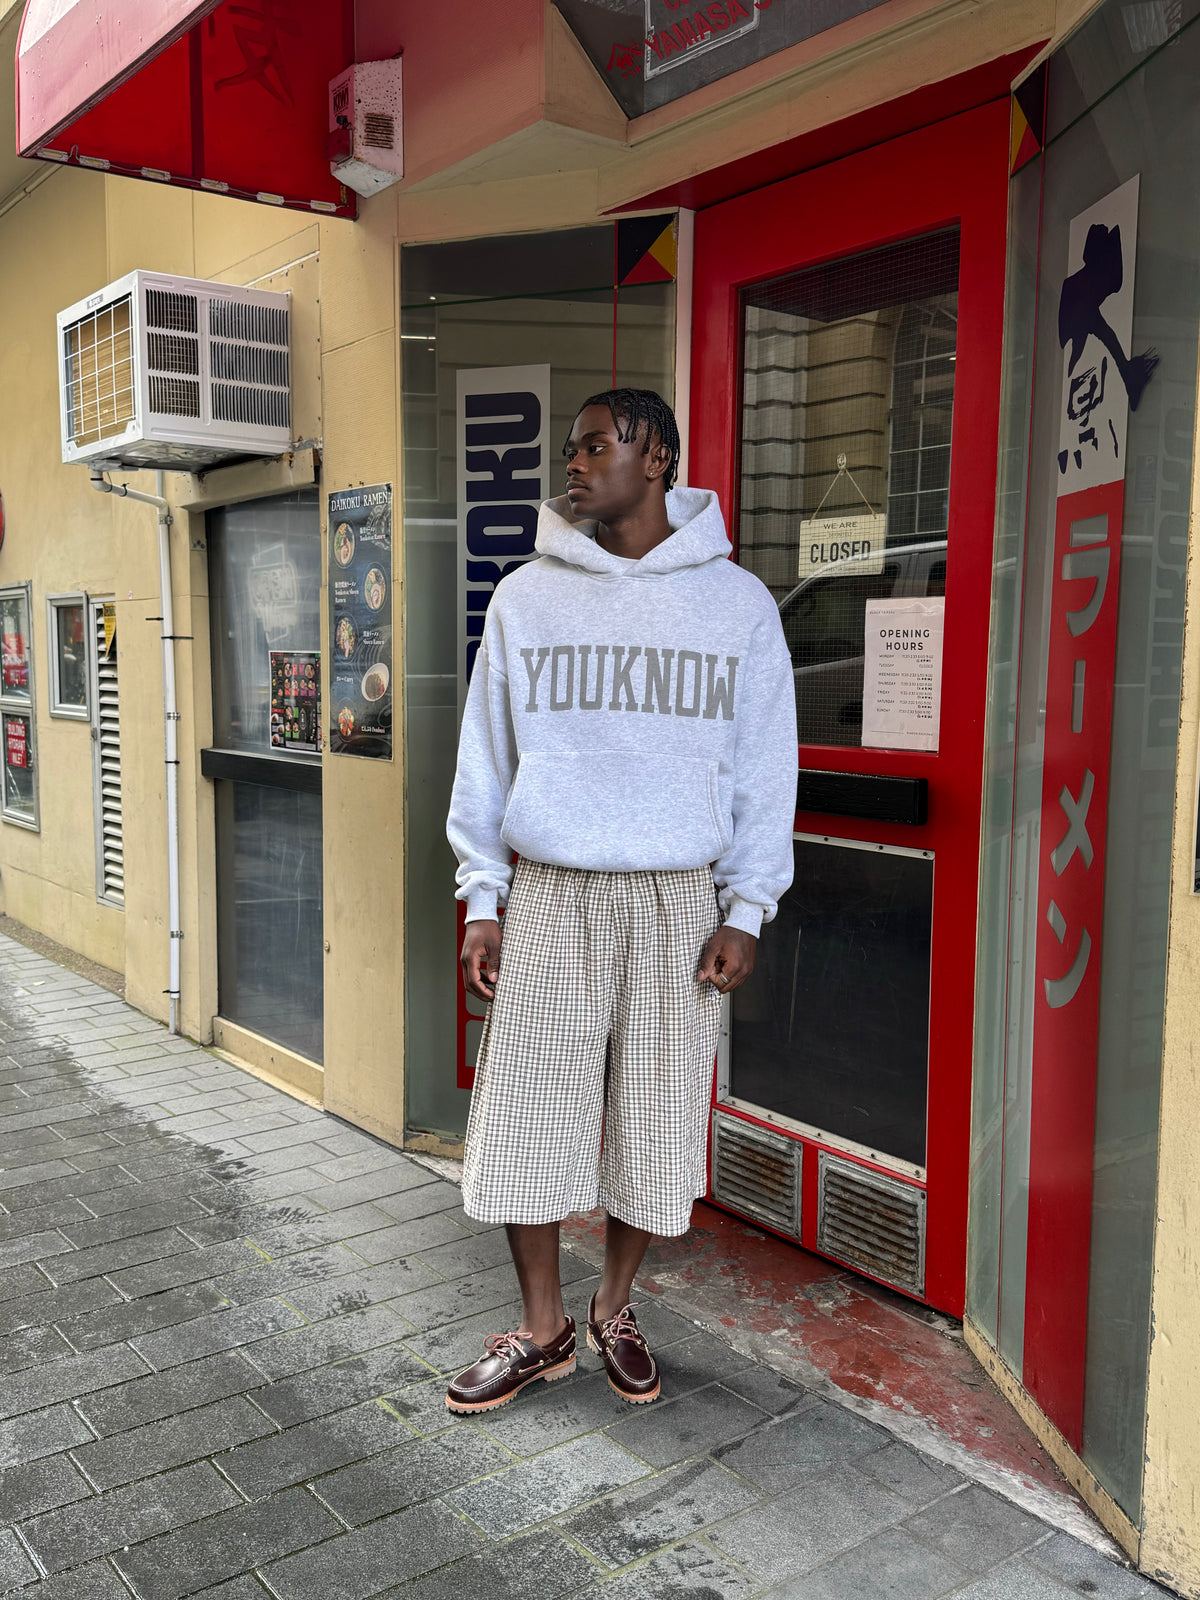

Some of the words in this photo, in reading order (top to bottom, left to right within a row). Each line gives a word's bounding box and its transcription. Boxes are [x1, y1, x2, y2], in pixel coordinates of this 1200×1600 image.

[644, 0, 750, 61] YAMASA
[331, 496, 361, 512] DAIKOKU
[363, 491, 388, 507] RAMEN
[810, 540, 871, 564] CLOSED
[879, 629, 930, 638] OPENING
[886, 642, 924, 651] HOURS
[520, 645, 740, 721] YOUKNOW
[8, 724, 25, 737] BUILDING
